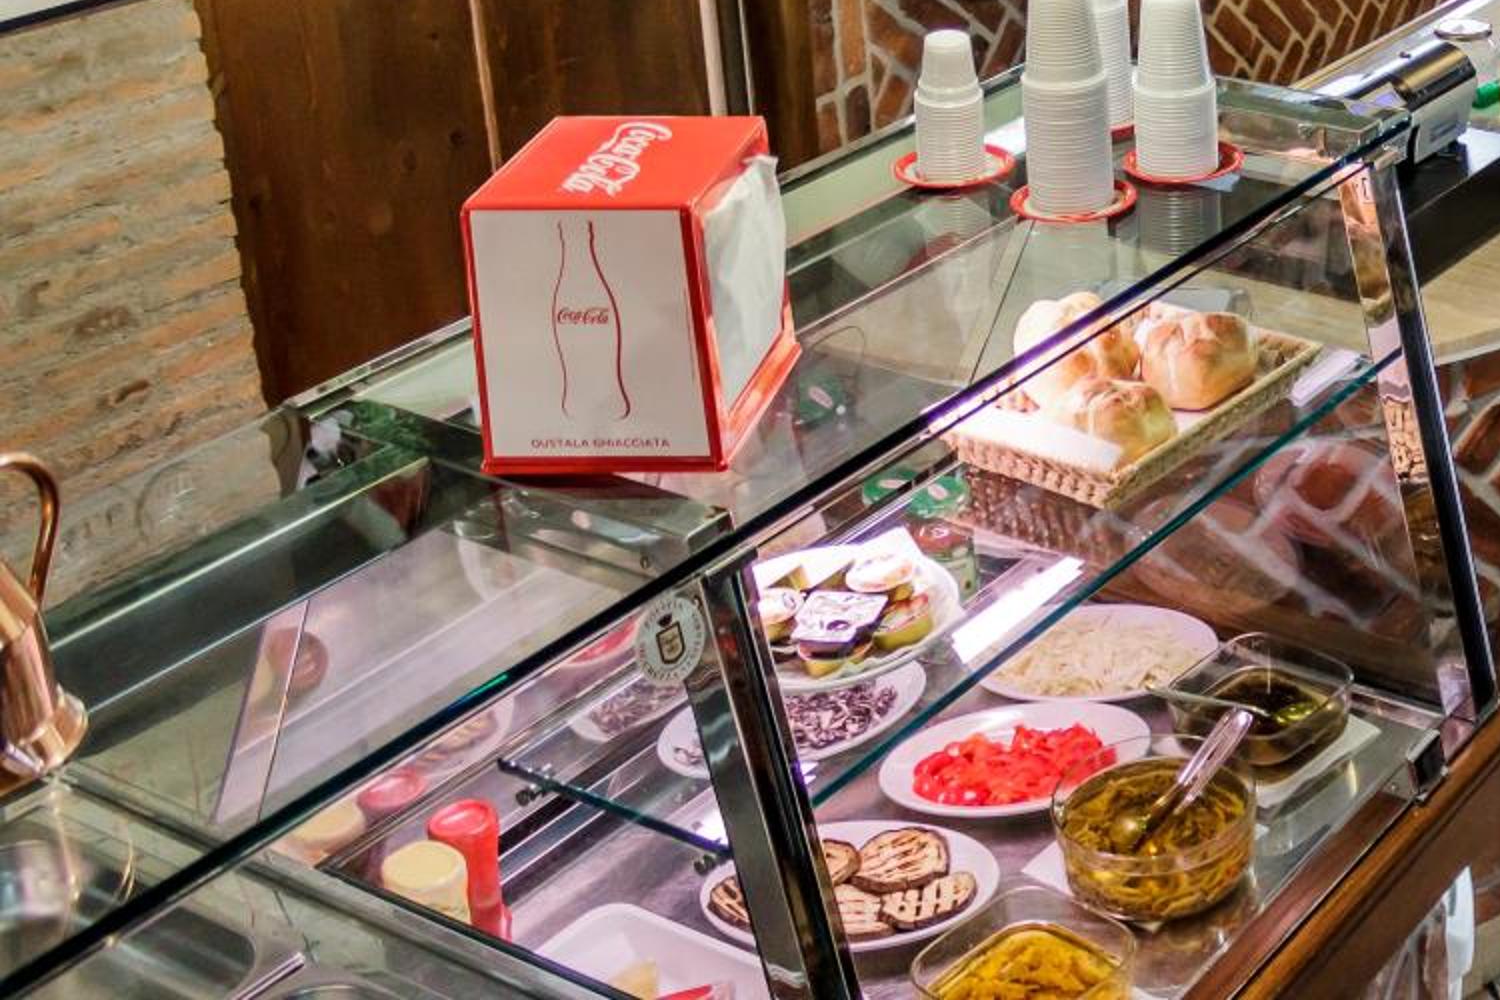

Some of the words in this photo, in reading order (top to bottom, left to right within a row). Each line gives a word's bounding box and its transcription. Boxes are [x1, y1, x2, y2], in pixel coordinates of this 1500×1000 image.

[560, 121, 673, 199] Coca-Cola
[556, 307, 610, 325] Coca-Cola
[531, 438, 590, 450] GUSTALA
[593, 437, 671, 450] GHIACCIATA
